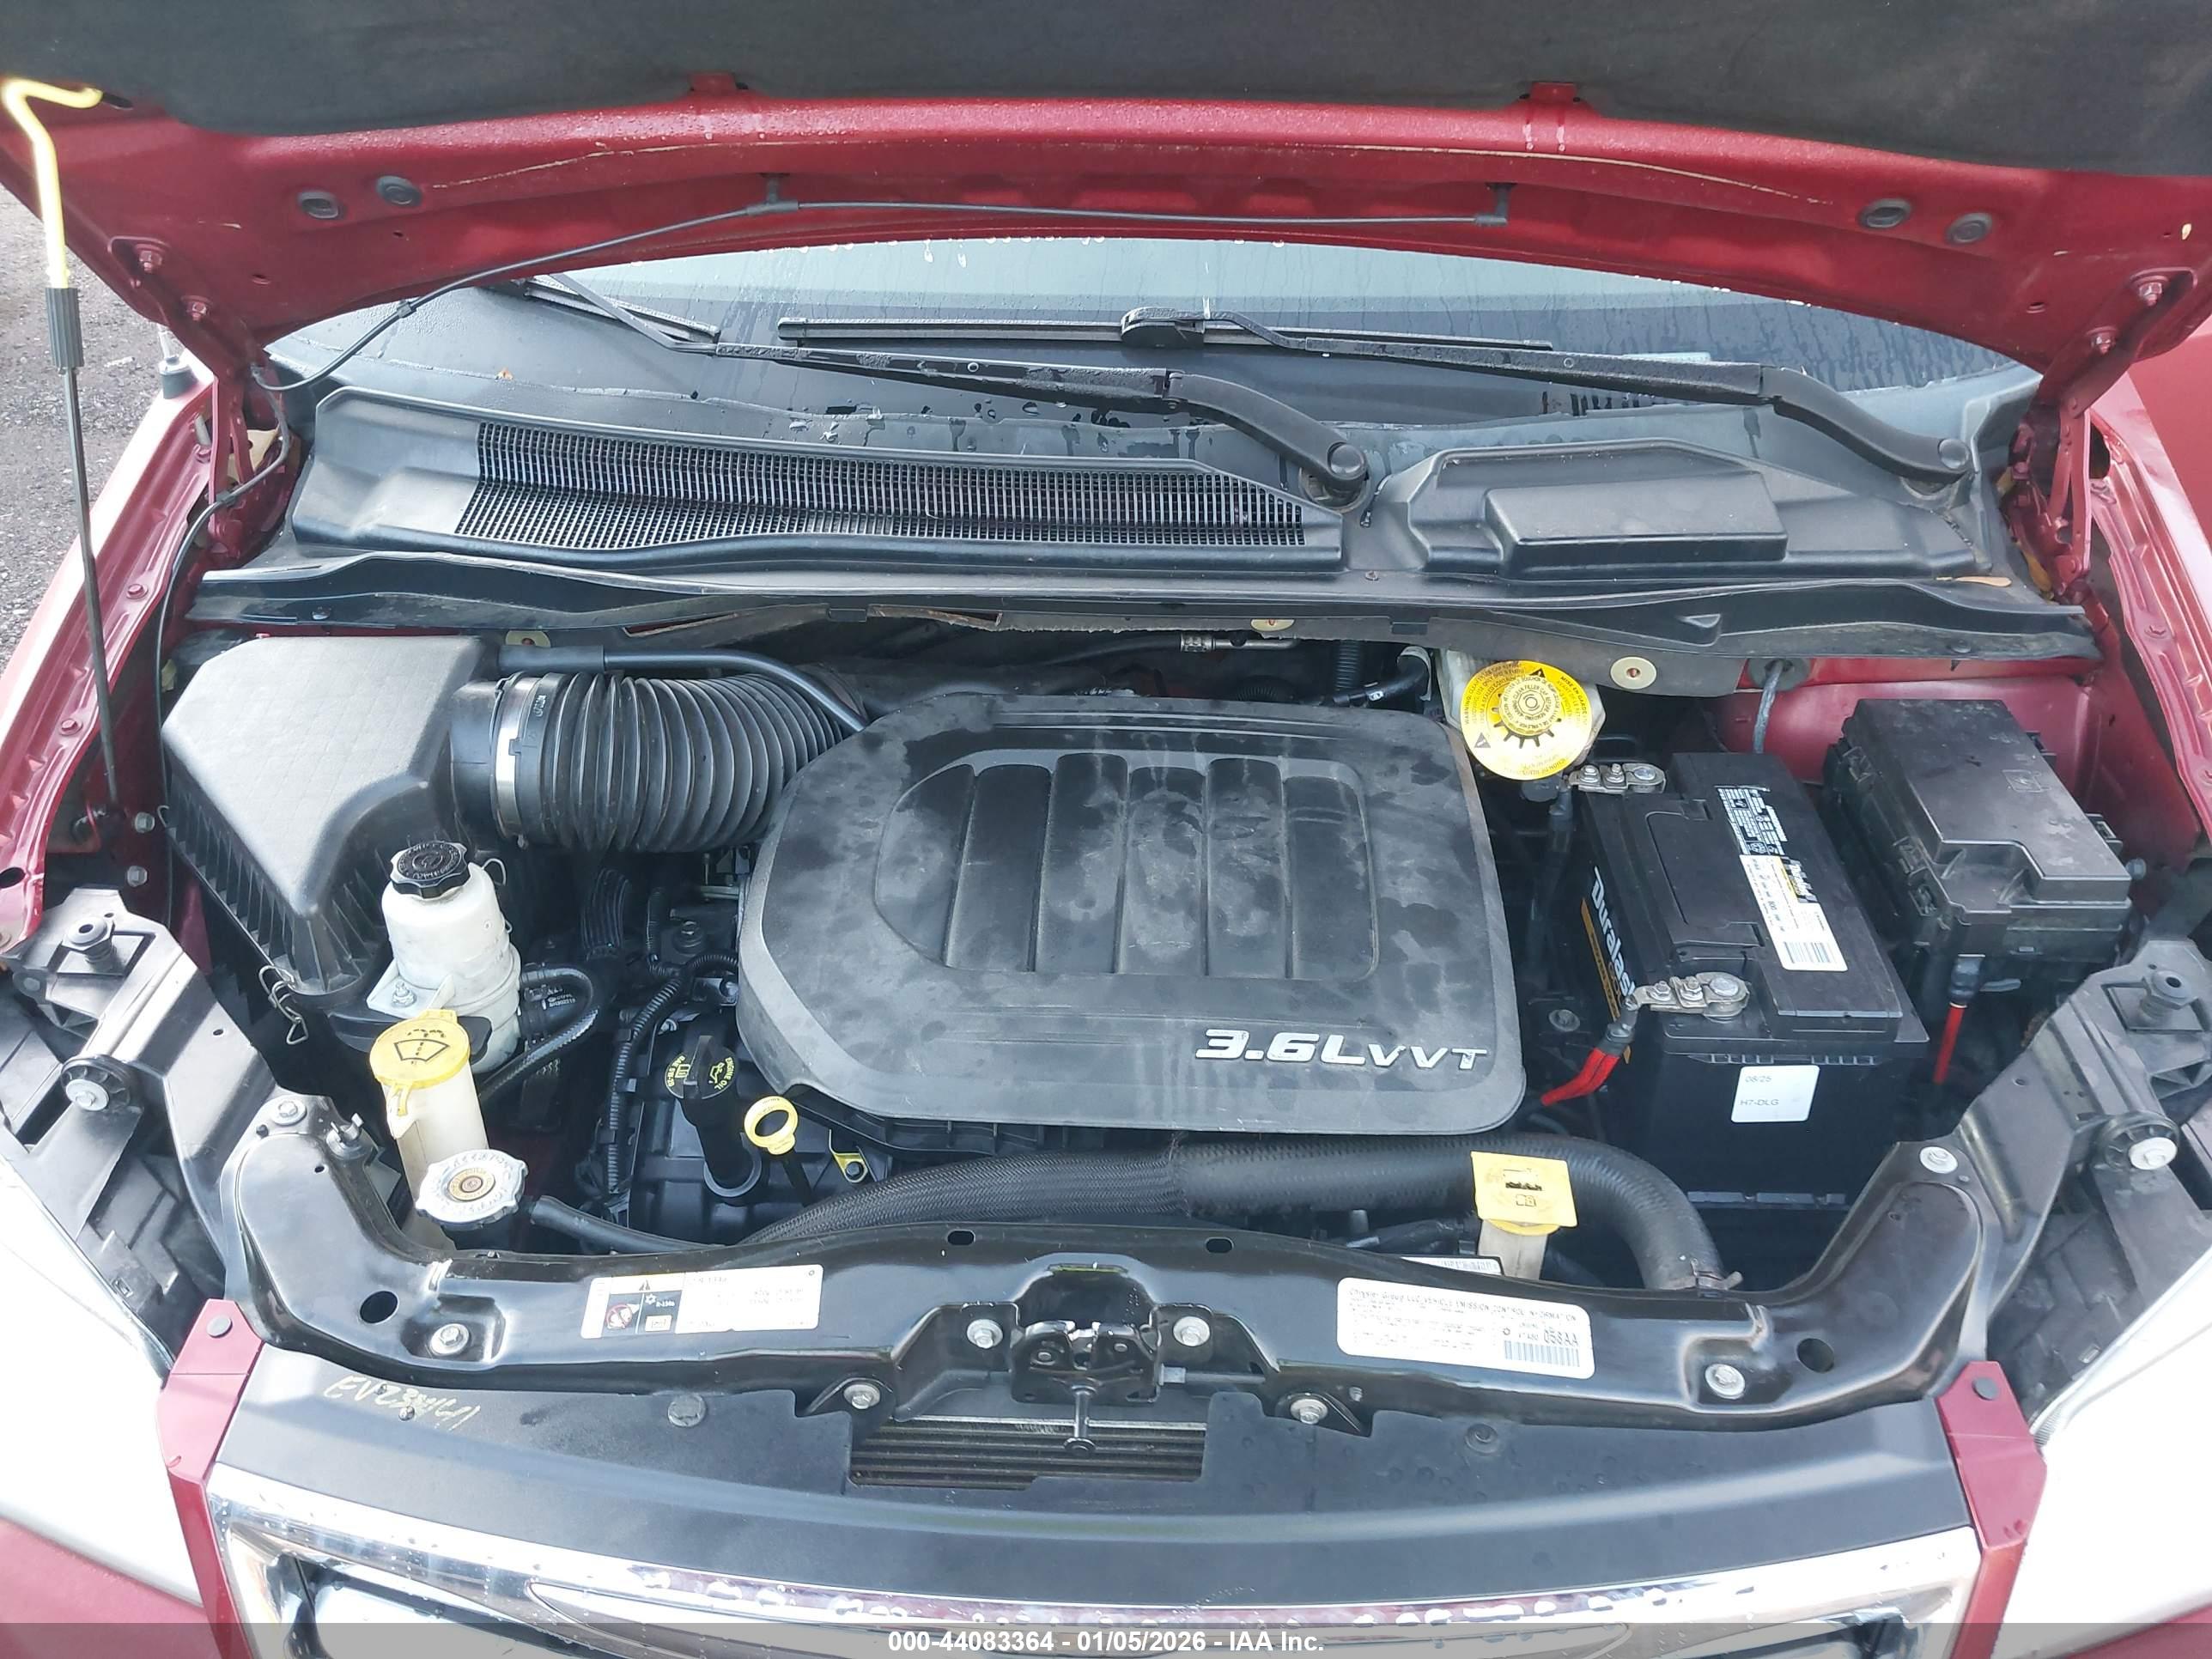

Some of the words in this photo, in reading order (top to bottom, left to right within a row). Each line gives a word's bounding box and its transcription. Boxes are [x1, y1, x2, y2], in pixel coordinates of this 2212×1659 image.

[1195, 1029, 1366, 1065] 3.6L
[1368, 1042, 1487, 1071] VVT
[725, 1057, 734, 1080] ENGINE
[714, 1079, 727, 1090] OIL
[1739, 1098, 1780, 1107] H7-DLG
